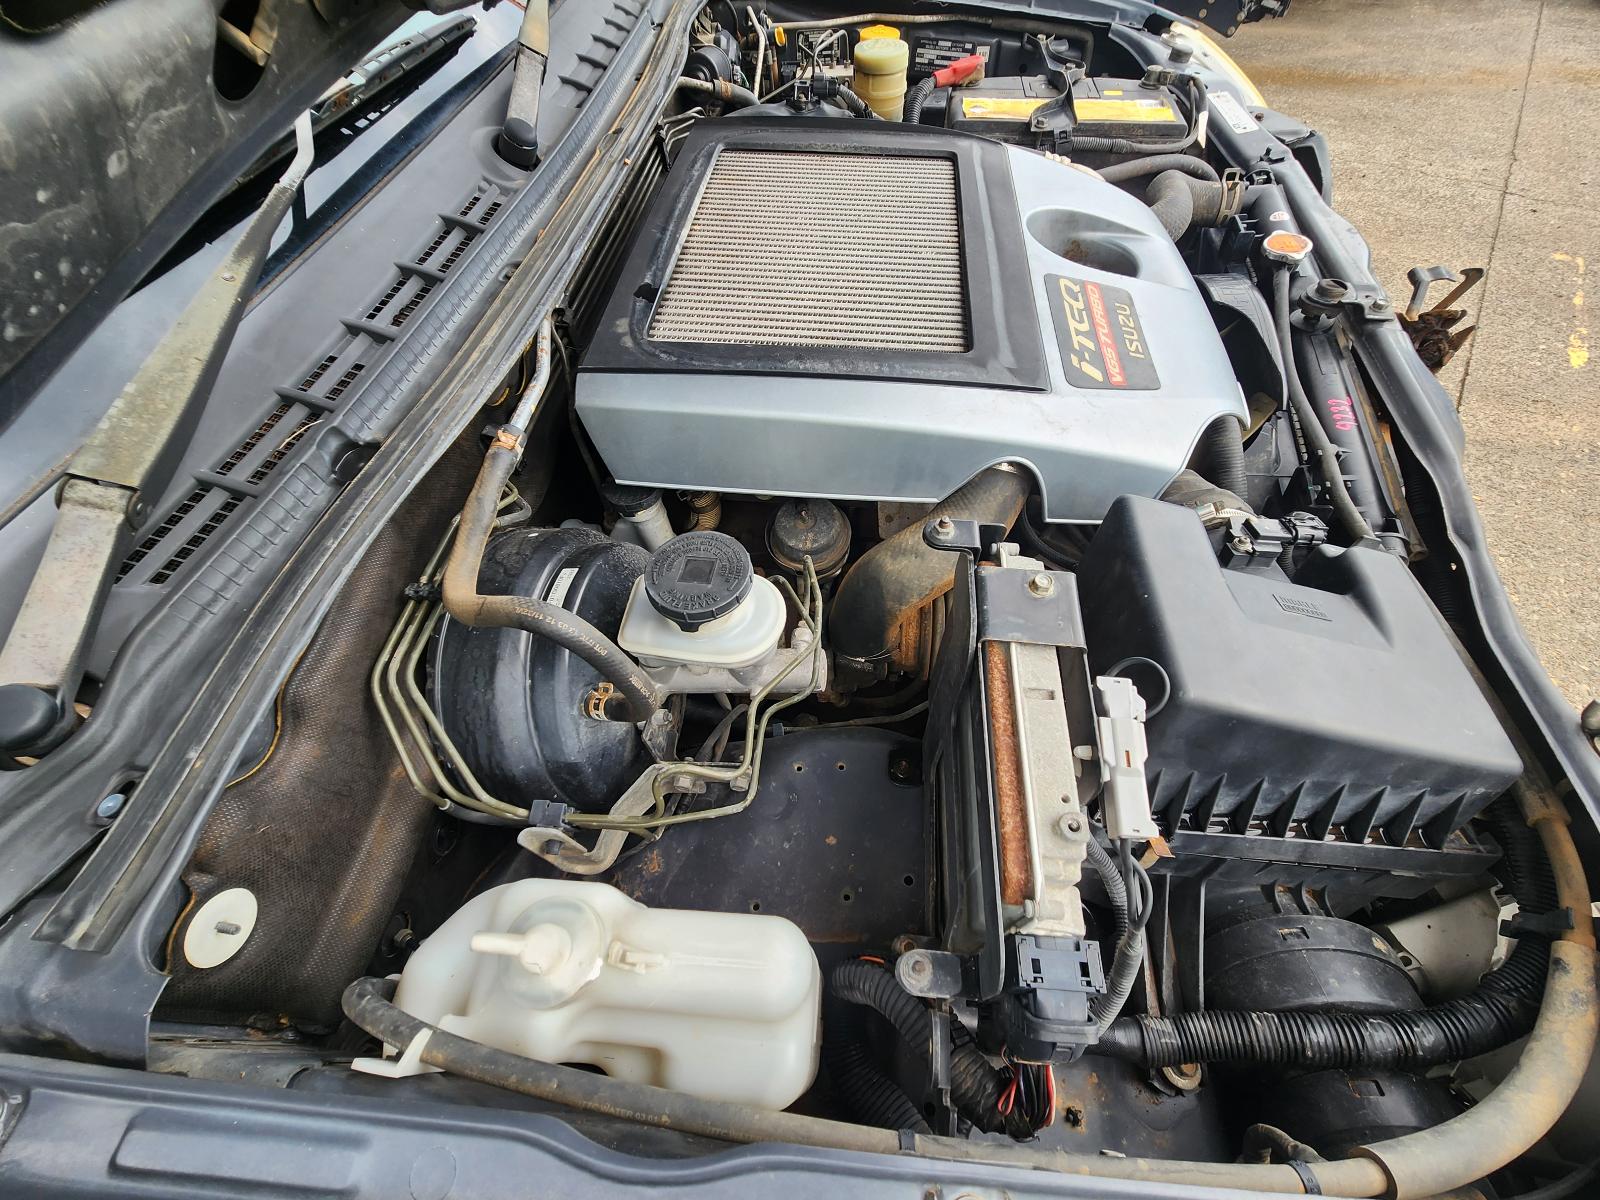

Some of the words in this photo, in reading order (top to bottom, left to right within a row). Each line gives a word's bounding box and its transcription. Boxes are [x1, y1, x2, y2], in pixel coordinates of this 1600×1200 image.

[1087, 284, 1112, 345] TURBO
[1114, 303, 1145, 358] ISUZU
[1103, 346, 1123, 382] VGS
[683, 594, 721, 610] BRAKE
